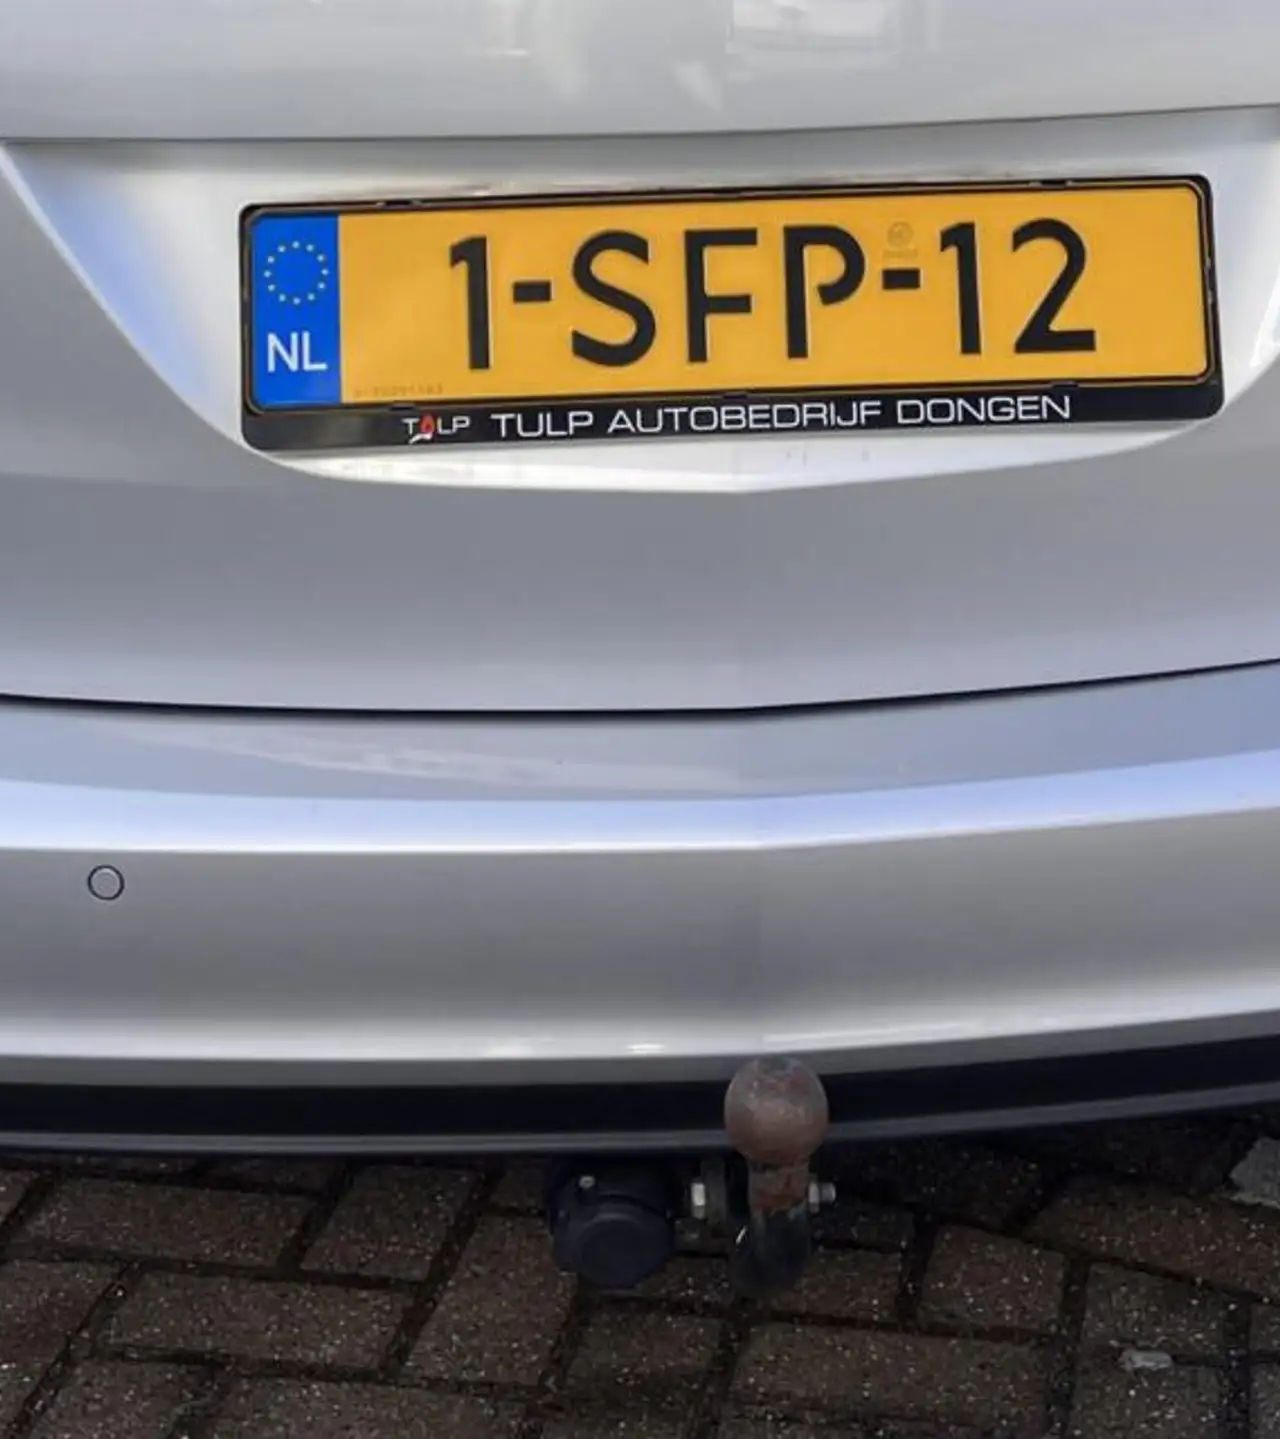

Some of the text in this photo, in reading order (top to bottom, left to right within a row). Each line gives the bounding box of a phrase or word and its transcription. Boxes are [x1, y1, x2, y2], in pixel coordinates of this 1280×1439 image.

[450, 219, 1096, 371] 1-SFP-12
[267, 333, 327, 372] NL
[490, 394, 1071, 438] TULP AUTOBEDRIJF DONGEN
